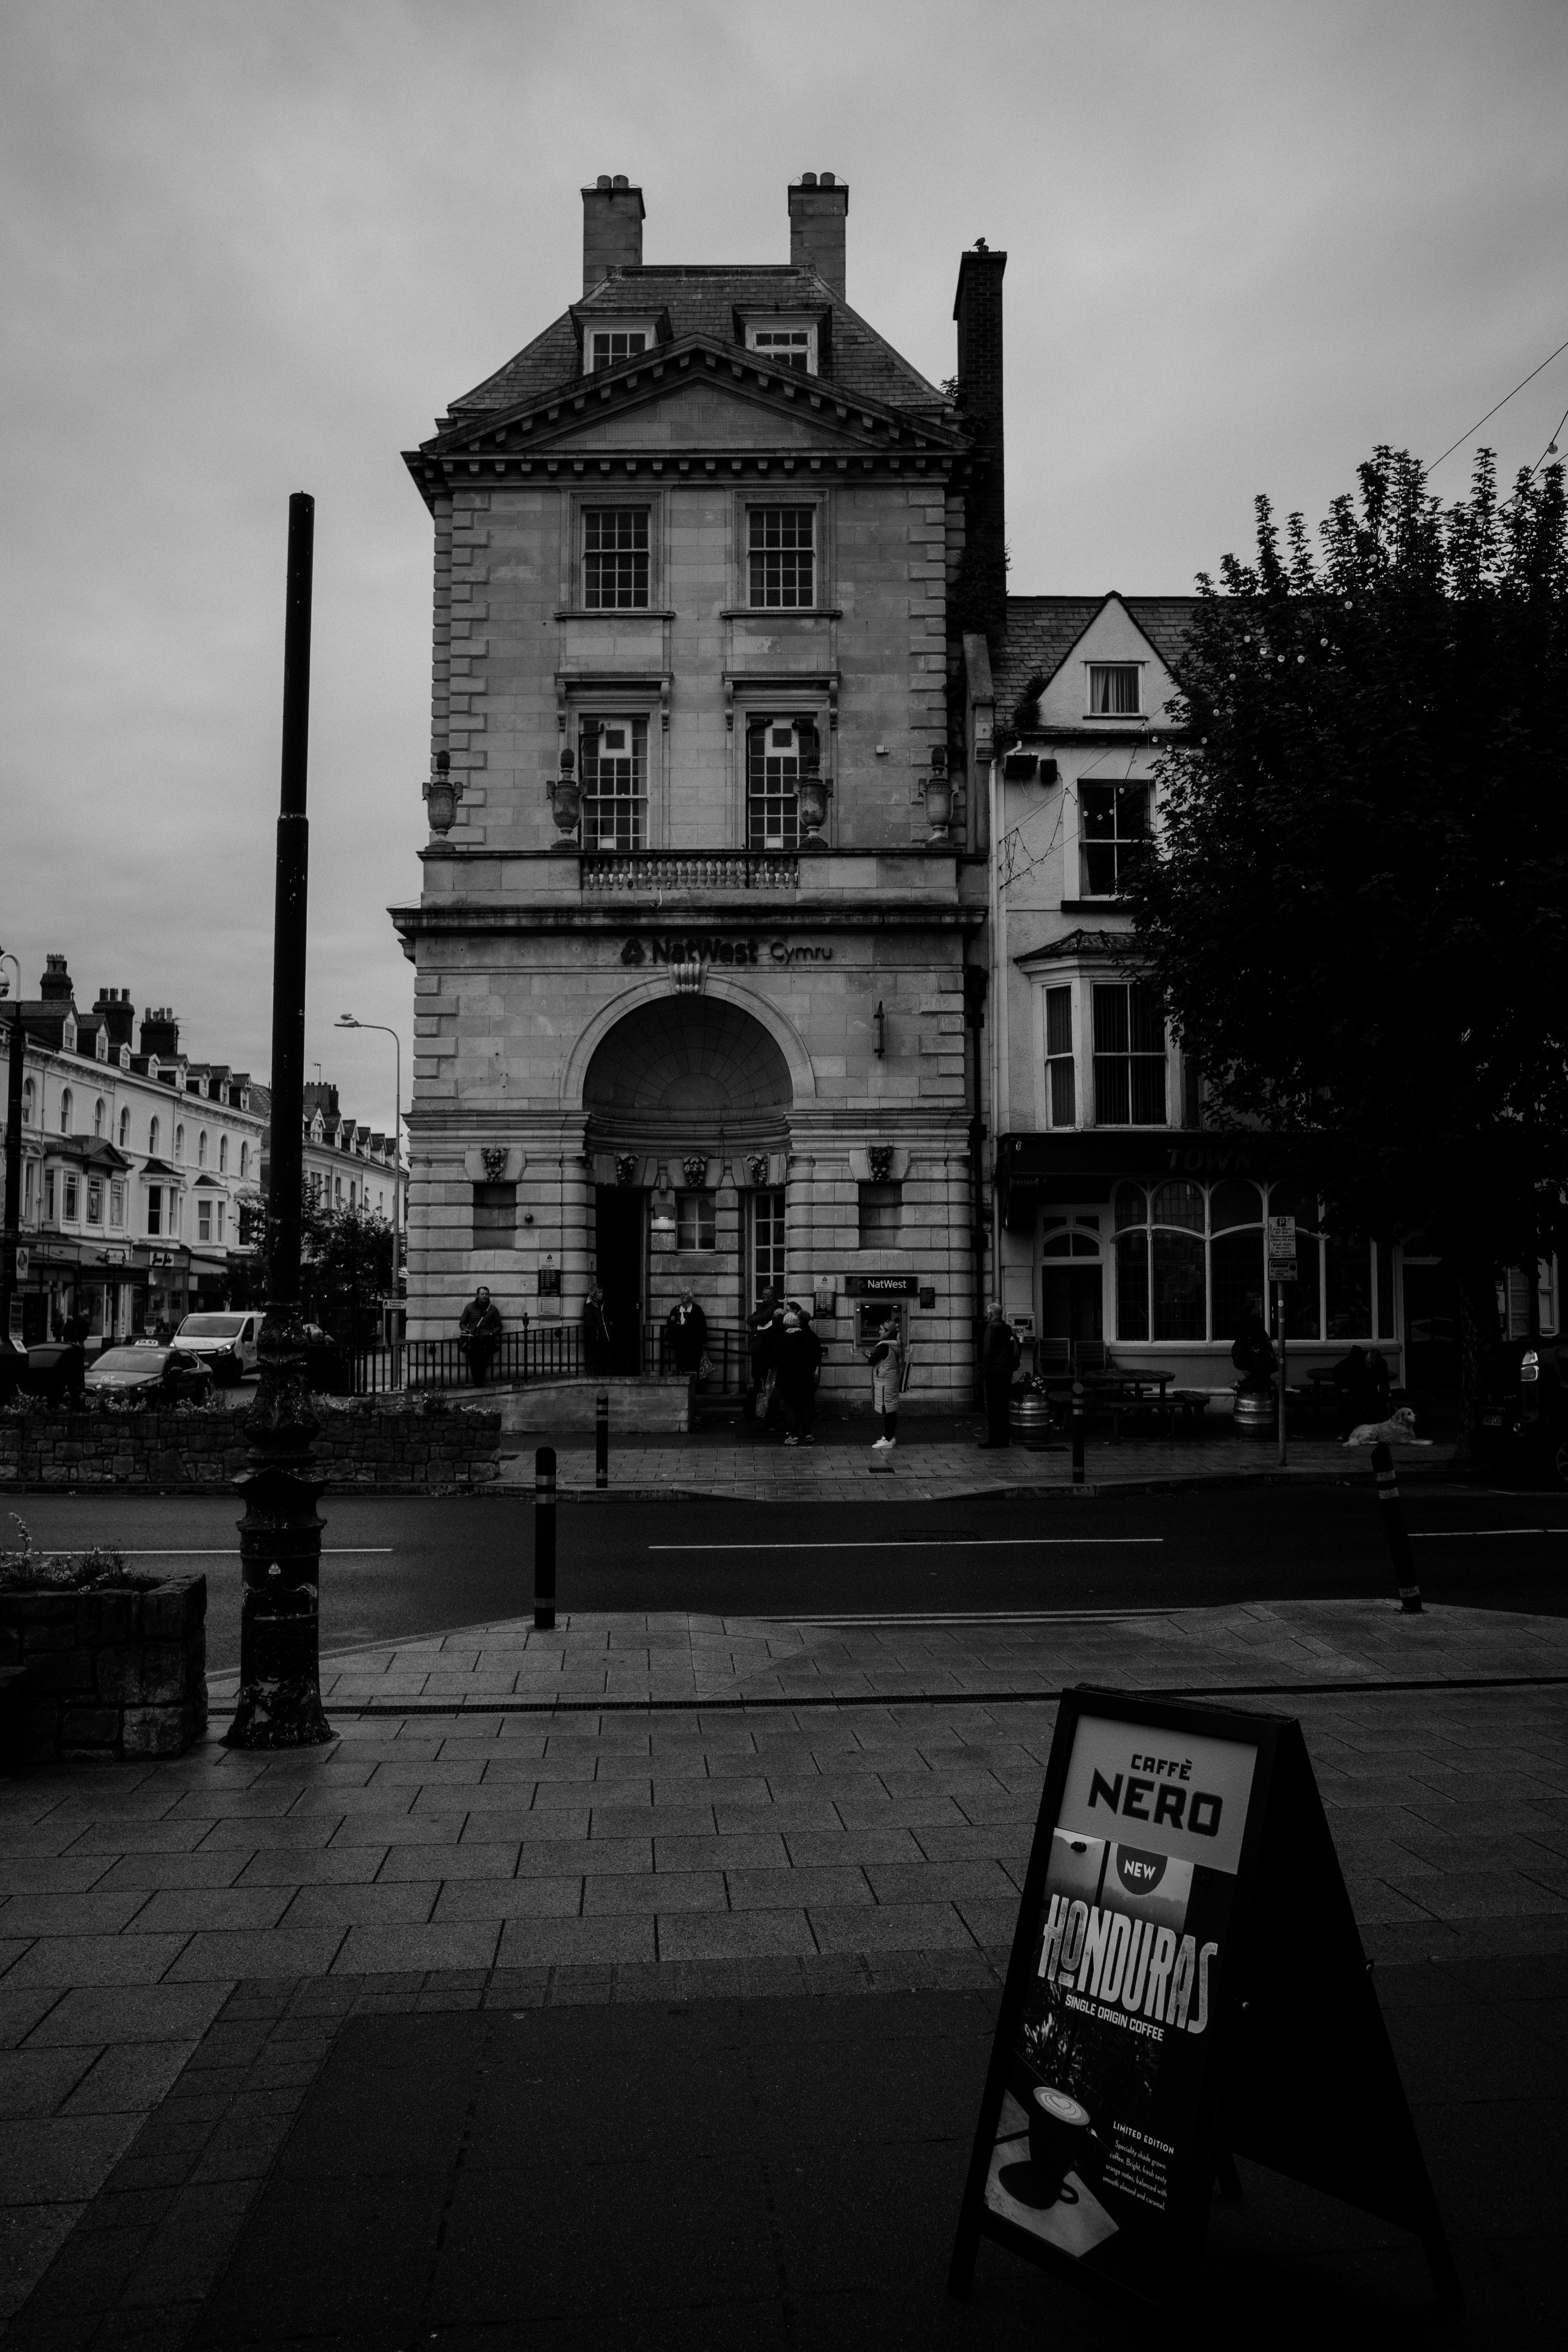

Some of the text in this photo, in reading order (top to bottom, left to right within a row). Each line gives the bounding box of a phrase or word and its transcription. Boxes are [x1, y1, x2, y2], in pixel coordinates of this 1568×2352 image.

[652, 938, 831, 965] NatWest Cymru
[1167, 1147, 1253, 1172] TOWN
[867, 1279, 907, 1289] NatWest
[1131, 1753, 1192, 1781] CAFFÈ
[1087, 1767, 1223, 1837] NERO
[1124, 1859, 1156, 1880] NEW
[1038, 1894, 1218, 2034] HONDURAS
[1065, 1994, 1164, 2042] SINGLE ORIGIN COFFEE
[1113, 2121, 1174, 2155] LIMITED EDITION
[1110, 2152, 1125, 2163] coffee.
[1142, 2165, 1154, 2178] fresh
[1155, 2174, 1167, 2185] zesty
[1115, 2140, 1166, 2170] Speciality shade grown
[1102, 2176, 1119, 2187] smooth
[1119, 2182, 1136, 2196] almond
[1146, 2197, 1165, 2210] caramel.
[1105, 2164, 1167, 2198] orange notes, balanced with
